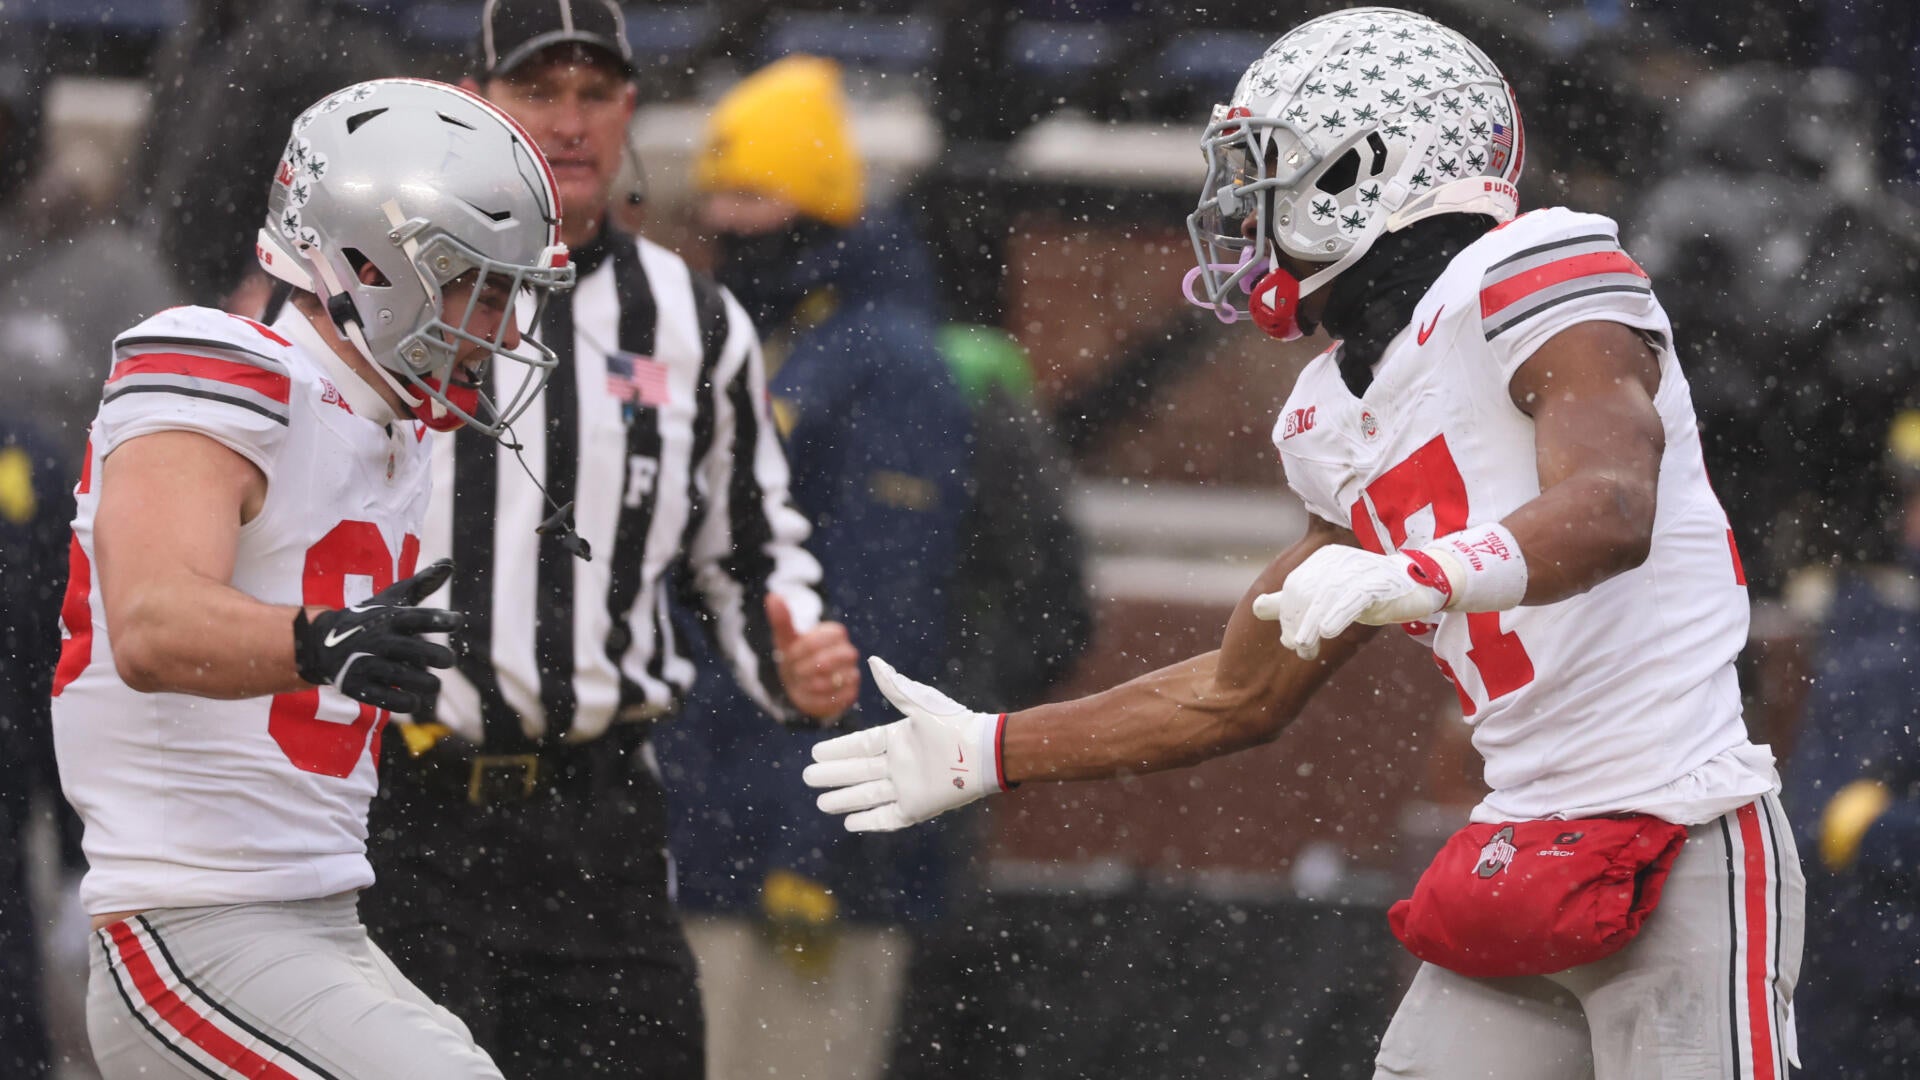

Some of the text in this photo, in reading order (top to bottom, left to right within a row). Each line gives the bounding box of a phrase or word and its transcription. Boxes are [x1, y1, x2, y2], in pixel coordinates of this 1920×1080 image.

[626, 455, 658, 507] F
[1471, 539, 1497, 555] 17
[1486, 532, 1511, 561] TOUCH
